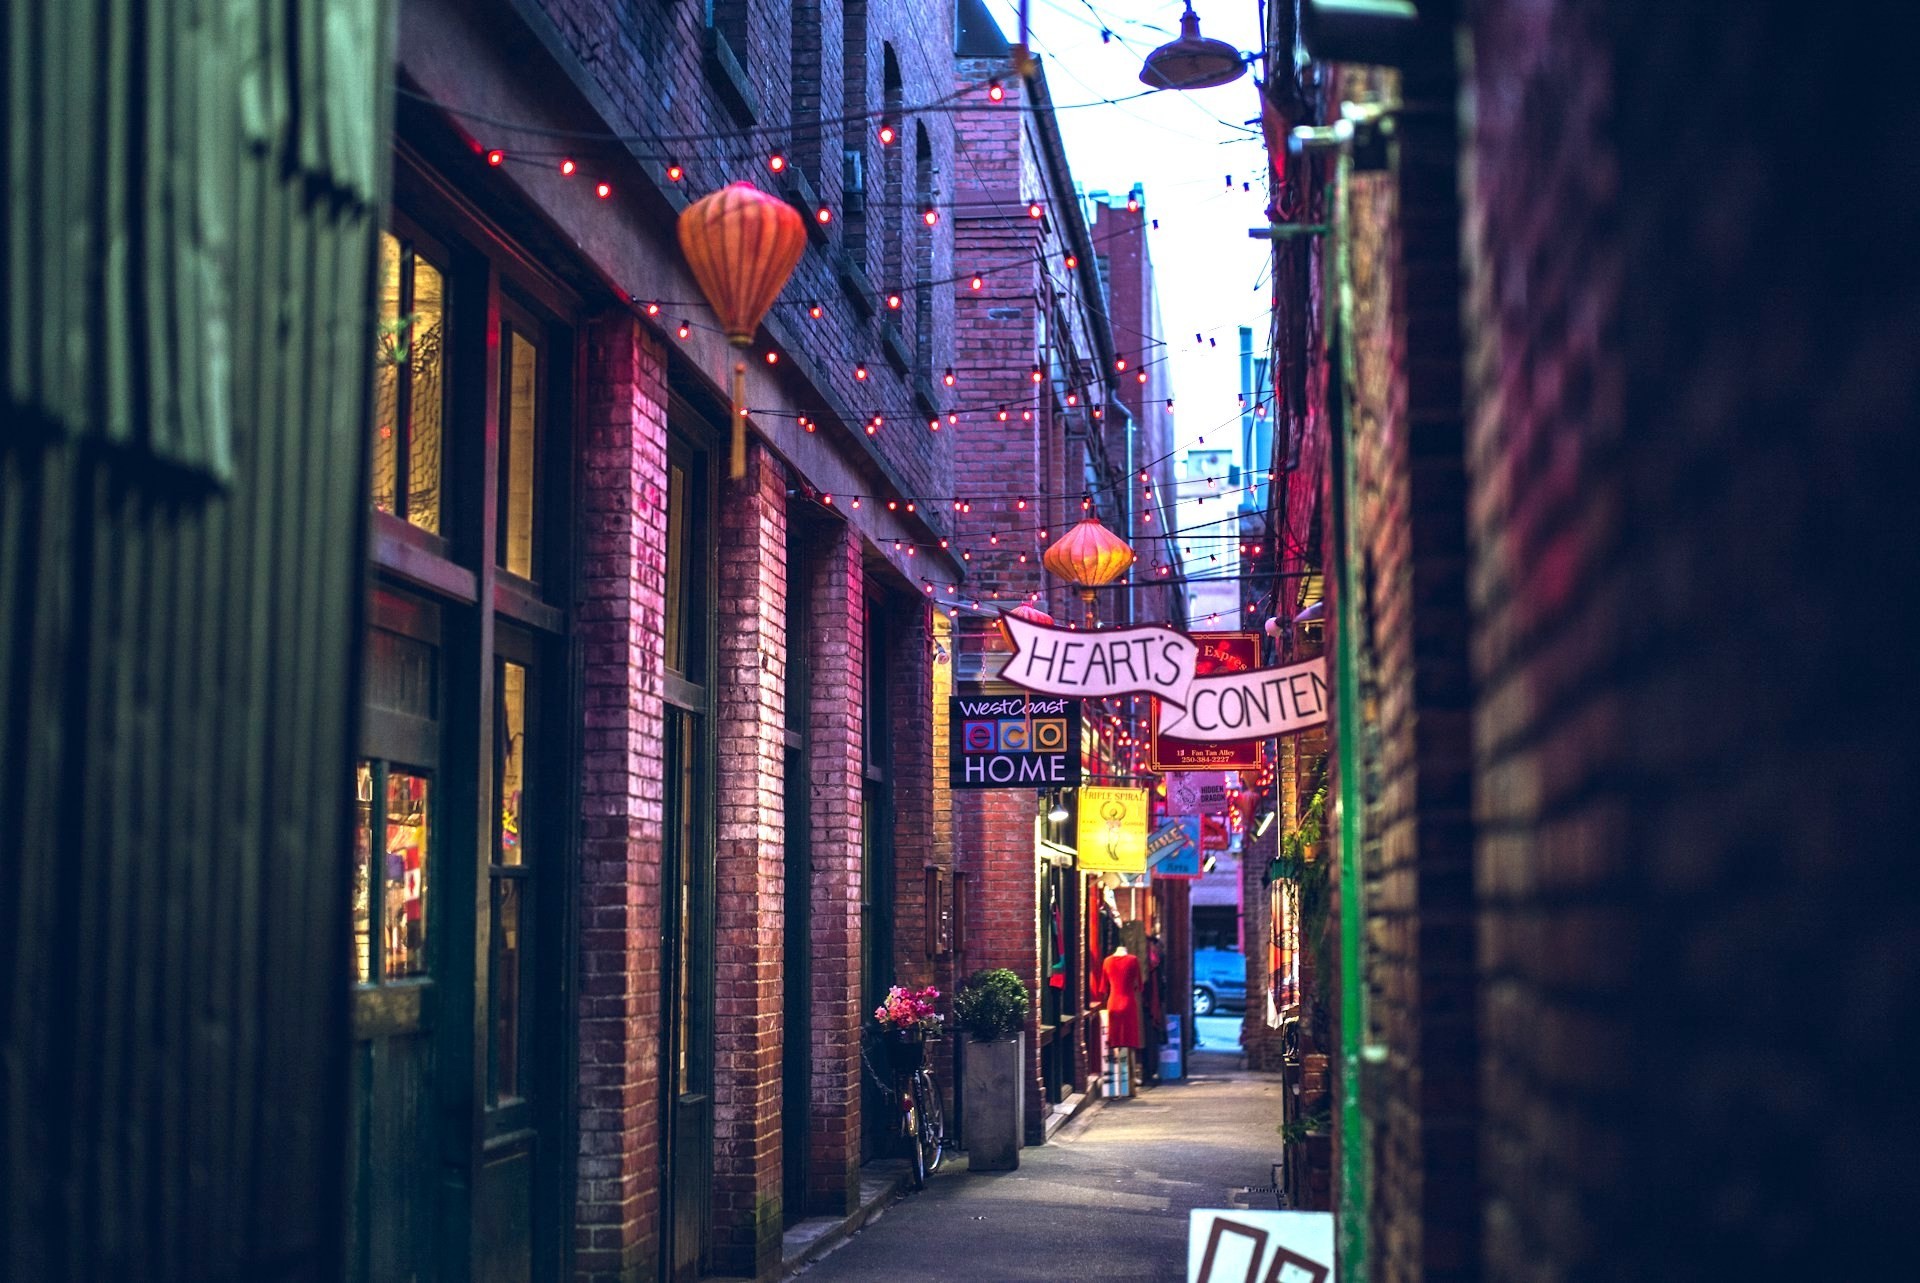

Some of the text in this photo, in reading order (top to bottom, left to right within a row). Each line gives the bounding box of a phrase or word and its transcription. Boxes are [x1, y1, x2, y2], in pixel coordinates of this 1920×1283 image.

[1026, 635, 1184, 687] HEART'S
[969, 724, 1061, 748] eco
[1219, 749, 1235, 757] Alley
[965, 755, 1065, 782] HOME
[1083, 790, 1144, 801] TRIPLE SPIRAL
[1201, 785, 1224, 794] HIDDEN
